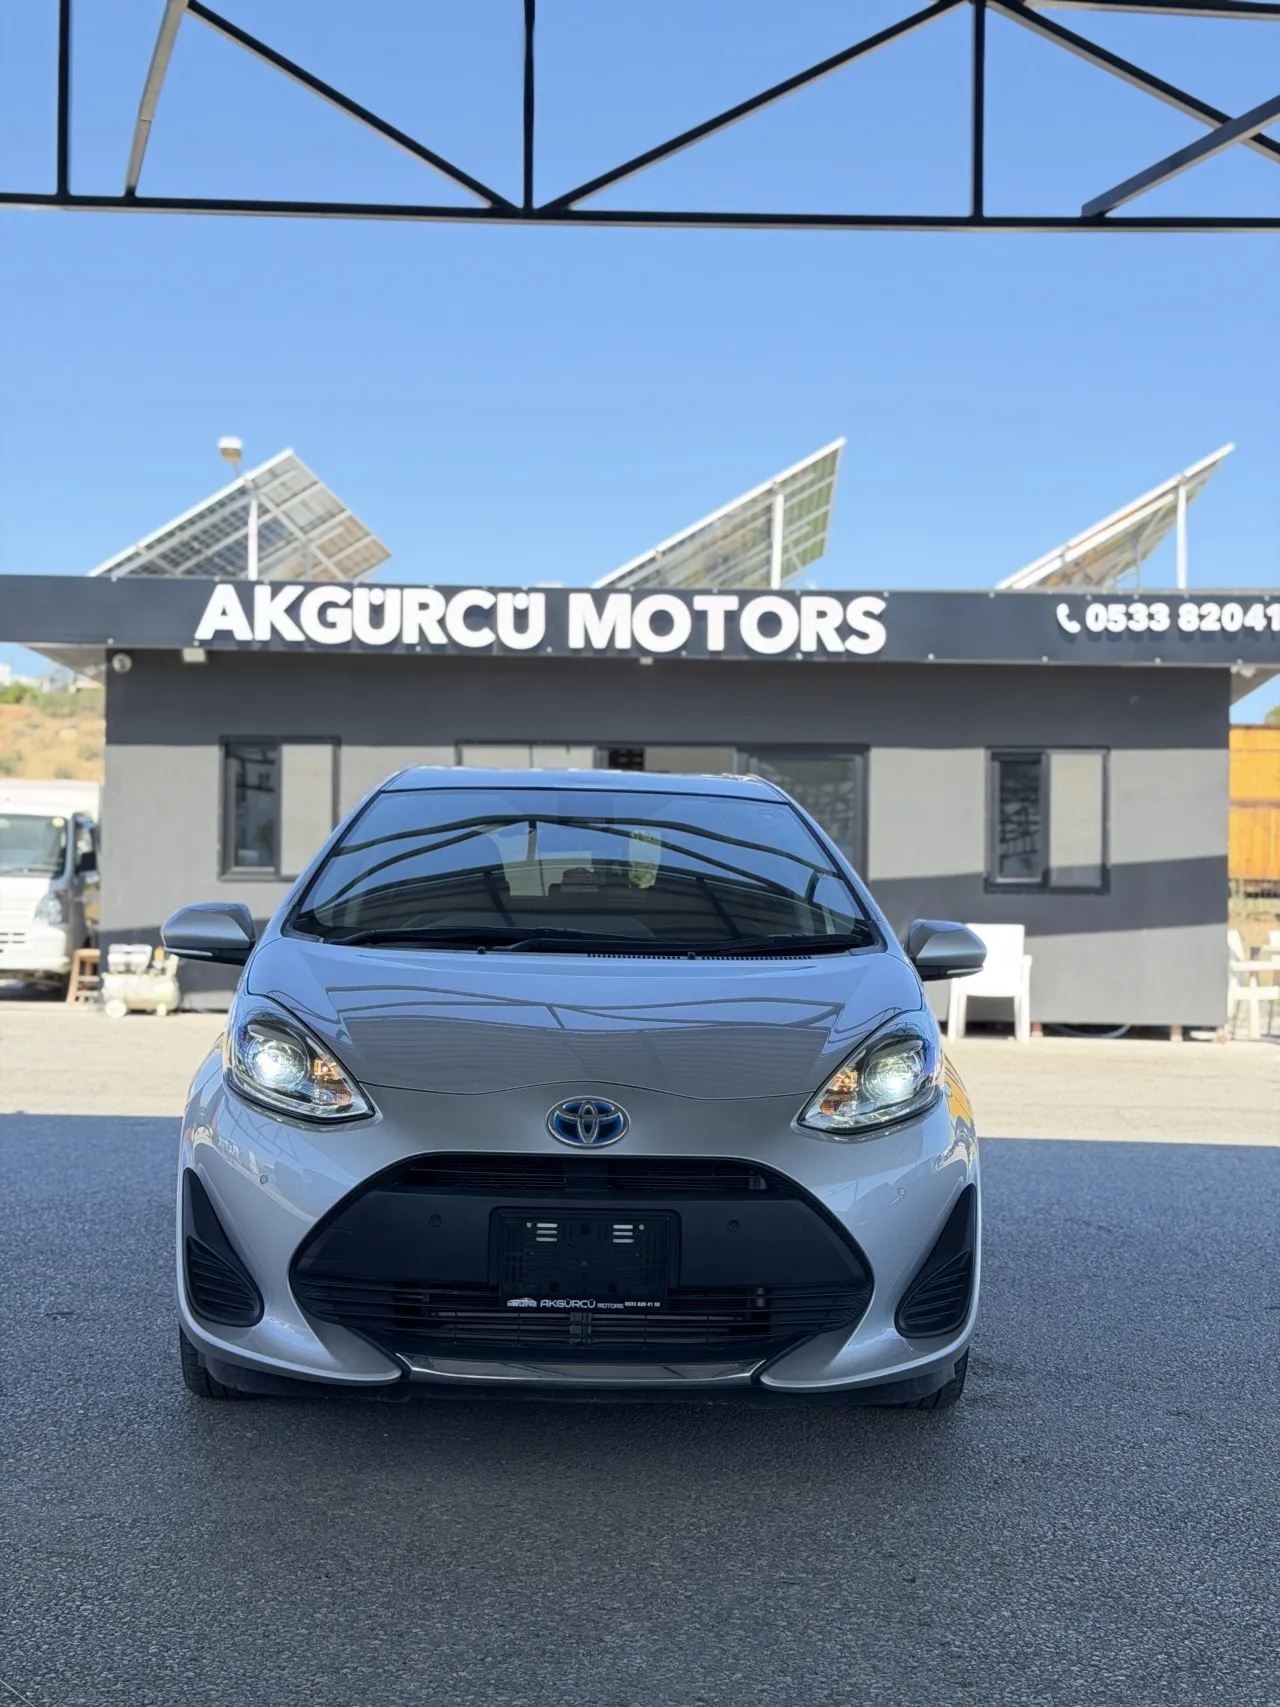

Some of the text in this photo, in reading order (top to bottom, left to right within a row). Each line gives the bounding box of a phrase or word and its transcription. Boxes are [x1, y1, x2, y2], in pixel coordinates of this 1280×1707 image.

[195, 584, 887, 654] AKGÜRCÜ MOTORS
[1085, 602, 1171, 632] 0533
[540, 1299, 596, 1308] AKGÜRCÜ
